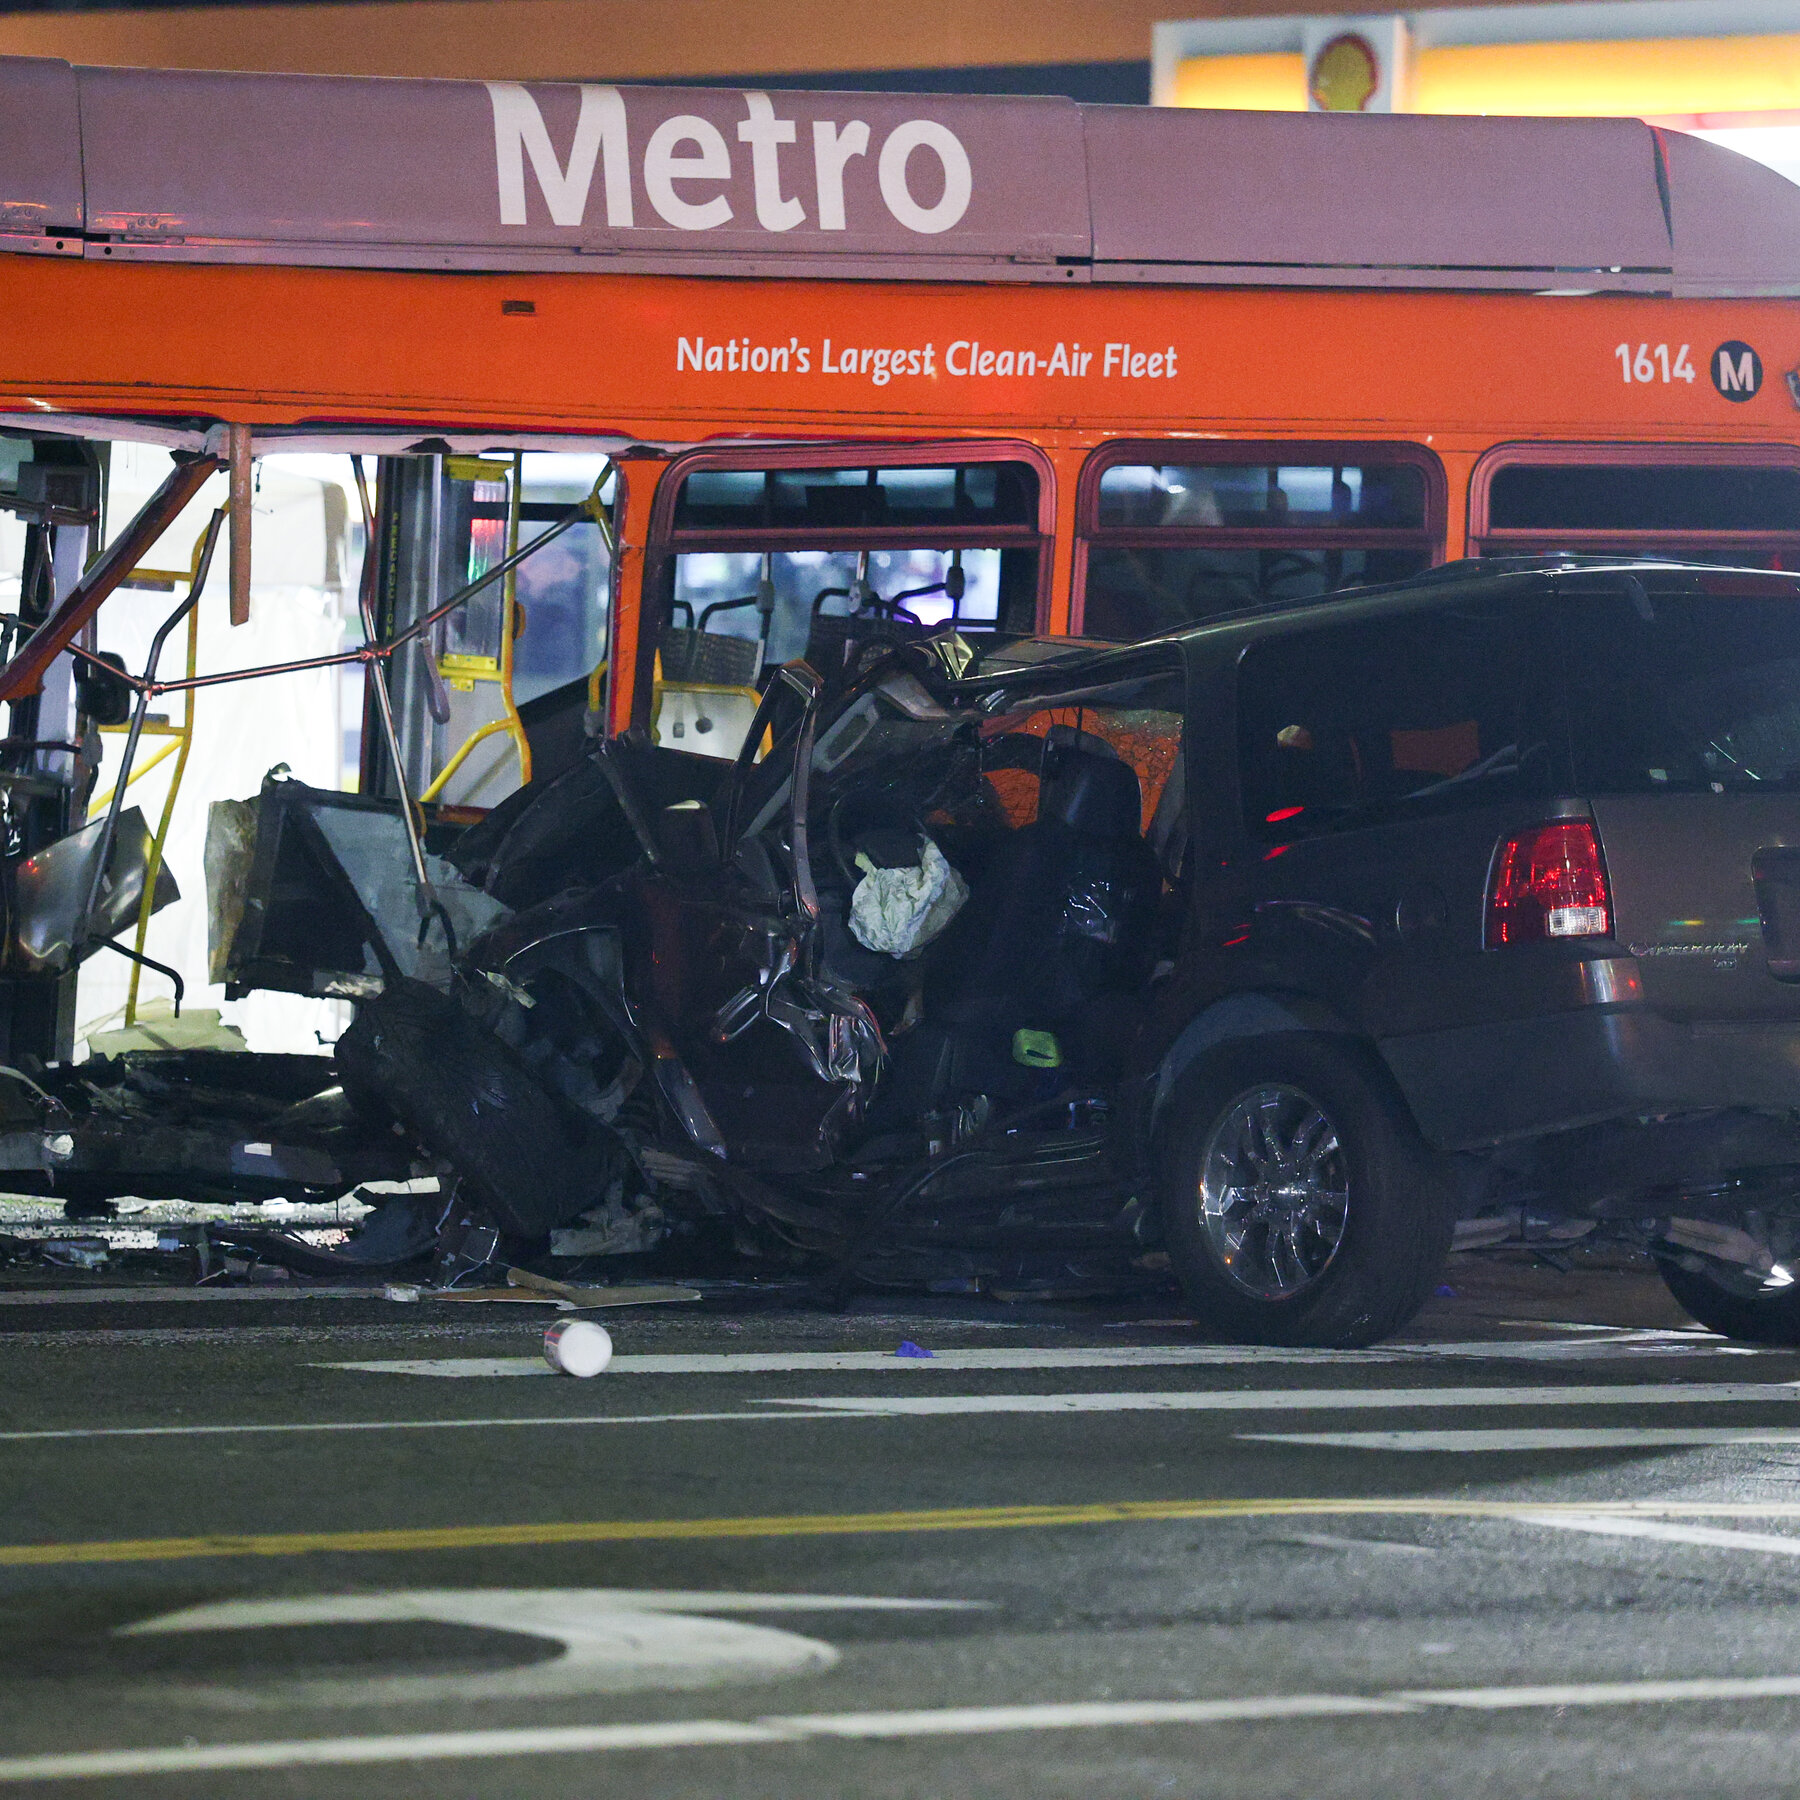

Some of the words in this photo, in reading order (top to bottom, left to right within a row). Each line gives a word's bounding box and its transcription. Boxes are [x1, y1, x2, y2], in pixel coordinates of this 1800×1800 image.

[484, 82, 973, 234] Metro
[821, 338, 936, 386] Largest
[945, 340, 1093, 377] Clean-Air
[1102, 342, 1178, 378] Fleet
[1614, 343, 1696, 384] 1614
[1717, 349, 1756, 393] M
